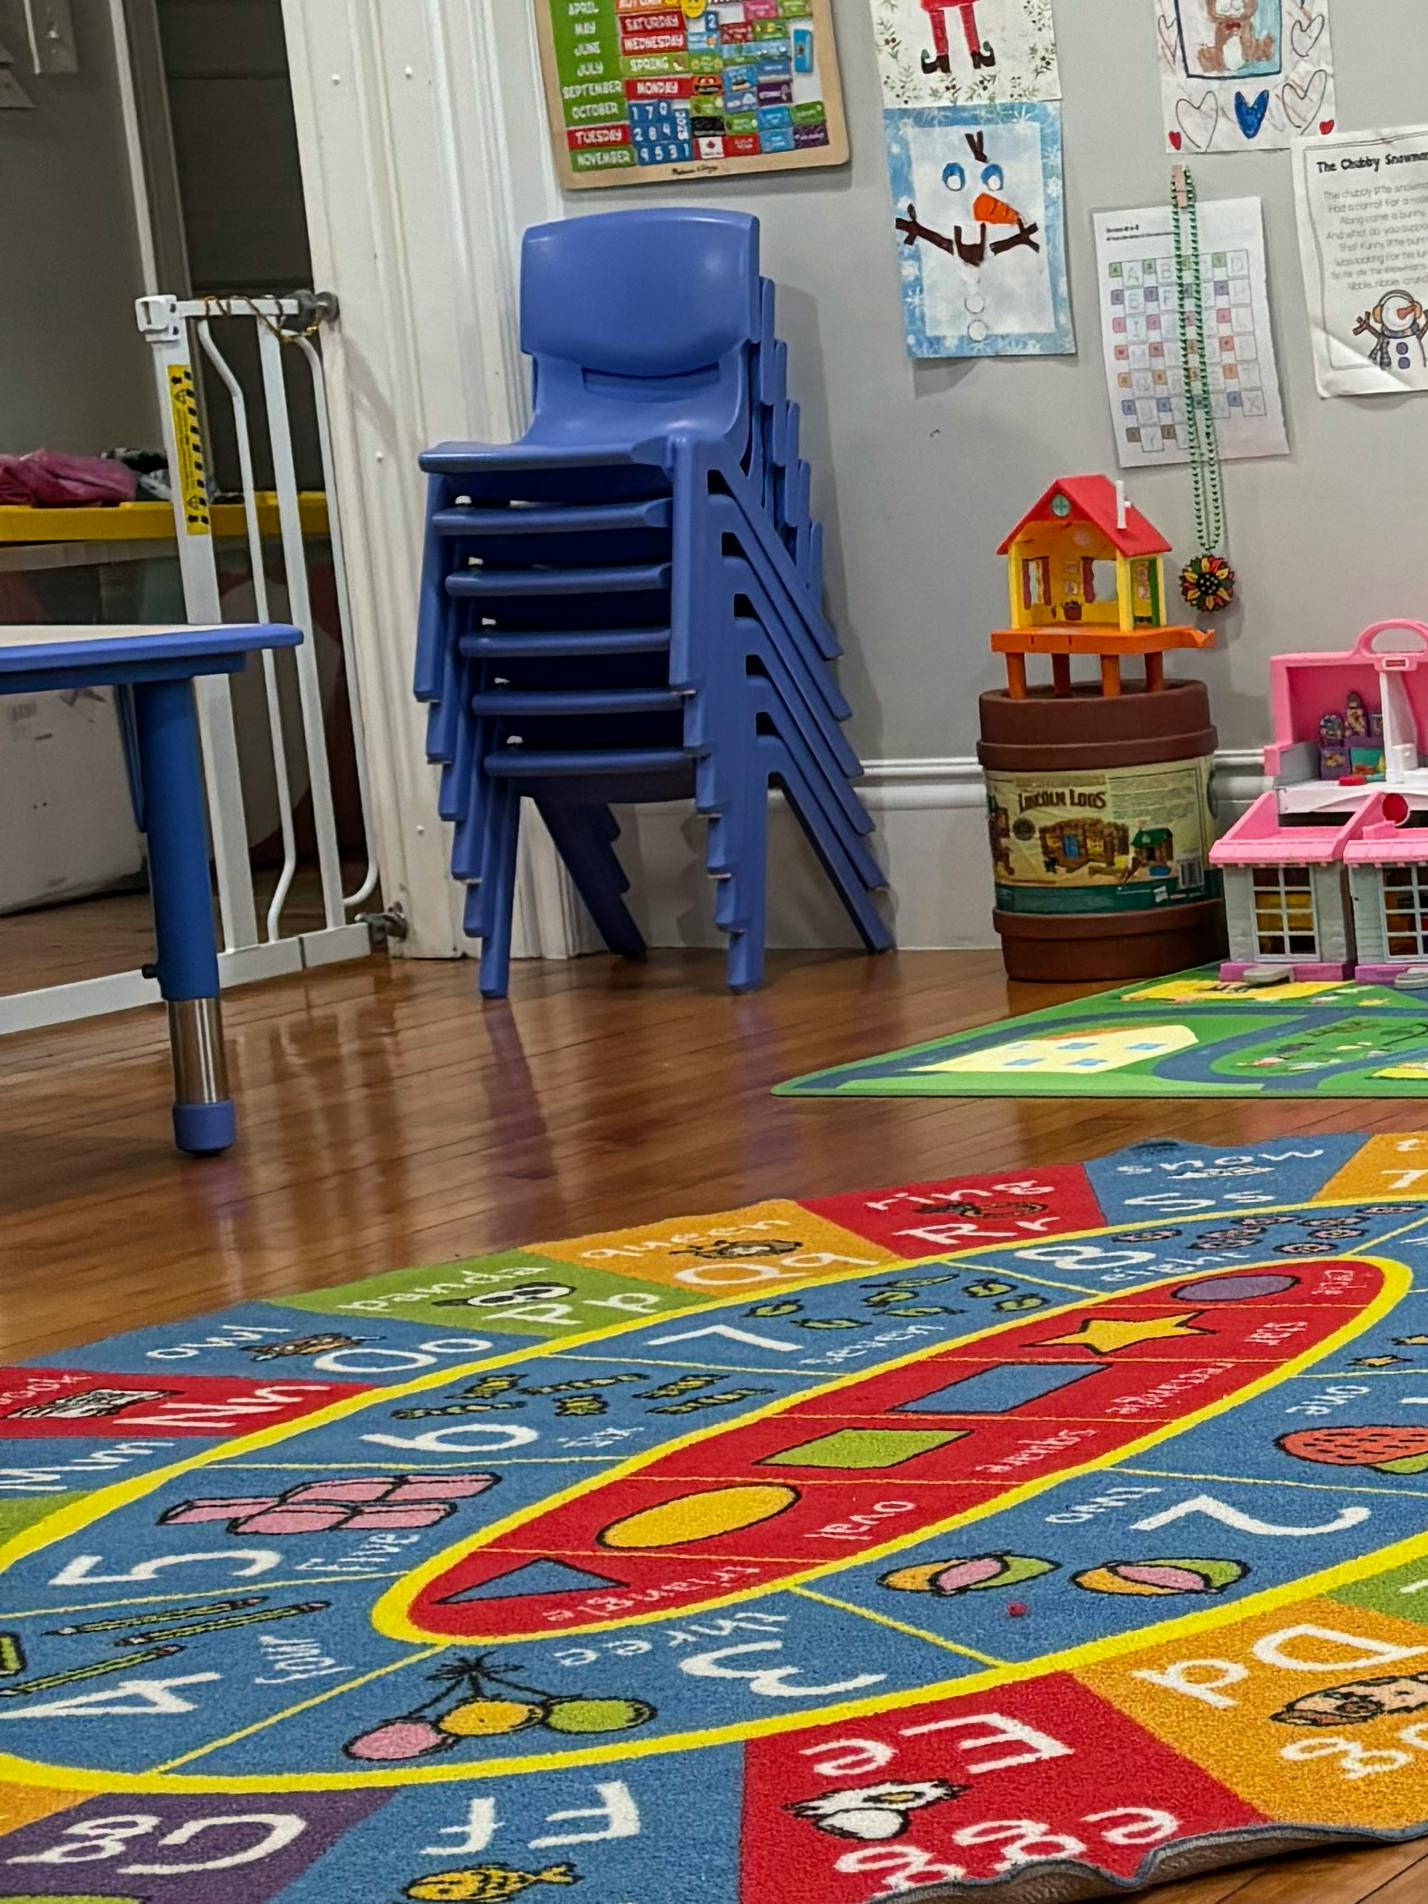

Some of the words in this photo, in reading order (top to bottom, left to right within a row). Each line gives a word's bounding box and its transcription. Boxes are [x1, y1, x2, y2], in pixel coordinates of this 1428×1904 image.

[568, 1, 599, 16] APRIL
[574, 22, 596, 35] MAY
[626, 15, 679, 31] SATURDAY
[575, 41, 601, 56] JUNE
[624, 34, 684, 51] WEDNESDAY
[577, 61, 603, 77] JULY
[630, 57, 668, 71] SPRING
[563, 80, 622, 99] SEPTEMBER
[637, 80, 678, 94] MONDAY
[572, 102, 618, 119] OCTOBER
[575, 128, 622, 144] TUESDAY
[577, 149, 631, 166] NOVEMBER
[1316, 160, 1337, 174] The
[1341, 157, 1380, 172] Chubby
[1018, 791, 1067, 812] LINCOLN
[1069, 789, 1106, 809] LOGS
[865, 1178, 1056, 1213] ring
[579, 1218, 790, 1262] queen
[337, 1265, 550, 1313] panda
[145, 1324, 292, 1362] owl
[803, 1499, 917, 1542] oval
[551, 1610, 791, 1668] three
[833, 1806, 1179, 1899] egg
